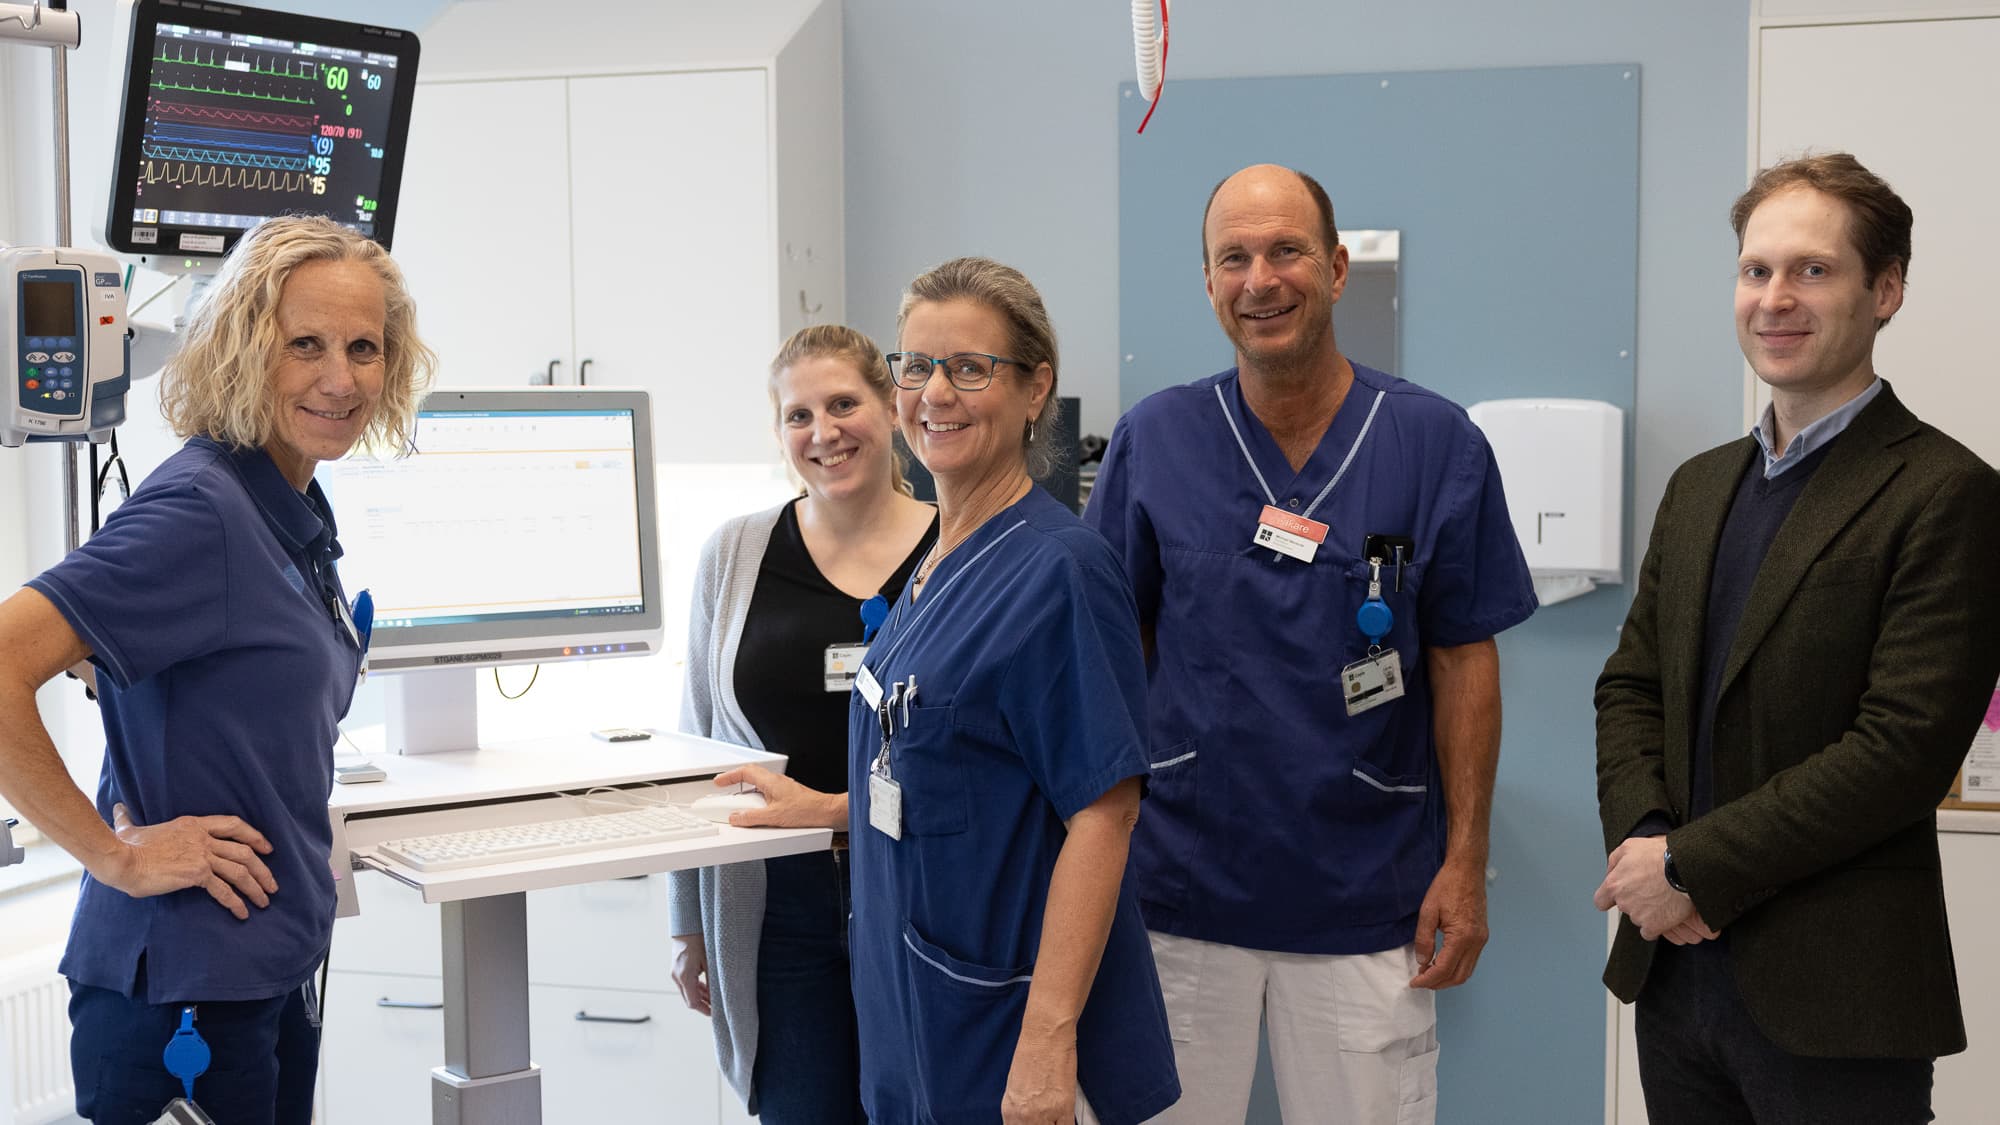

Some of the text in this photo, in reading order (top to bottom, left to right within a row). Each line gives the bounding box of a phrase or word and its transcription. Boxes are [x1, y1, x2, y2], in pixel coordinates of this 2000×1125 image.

[327, 66, 349, 91] 60
[367, 74, 382, 90] 60
[320, 124, 363, 139] 120/70 (91)
[317, 137, 334, 156] (9)
[315, 157, 331, 175] 95
[312, 176, 326, 195] 15
